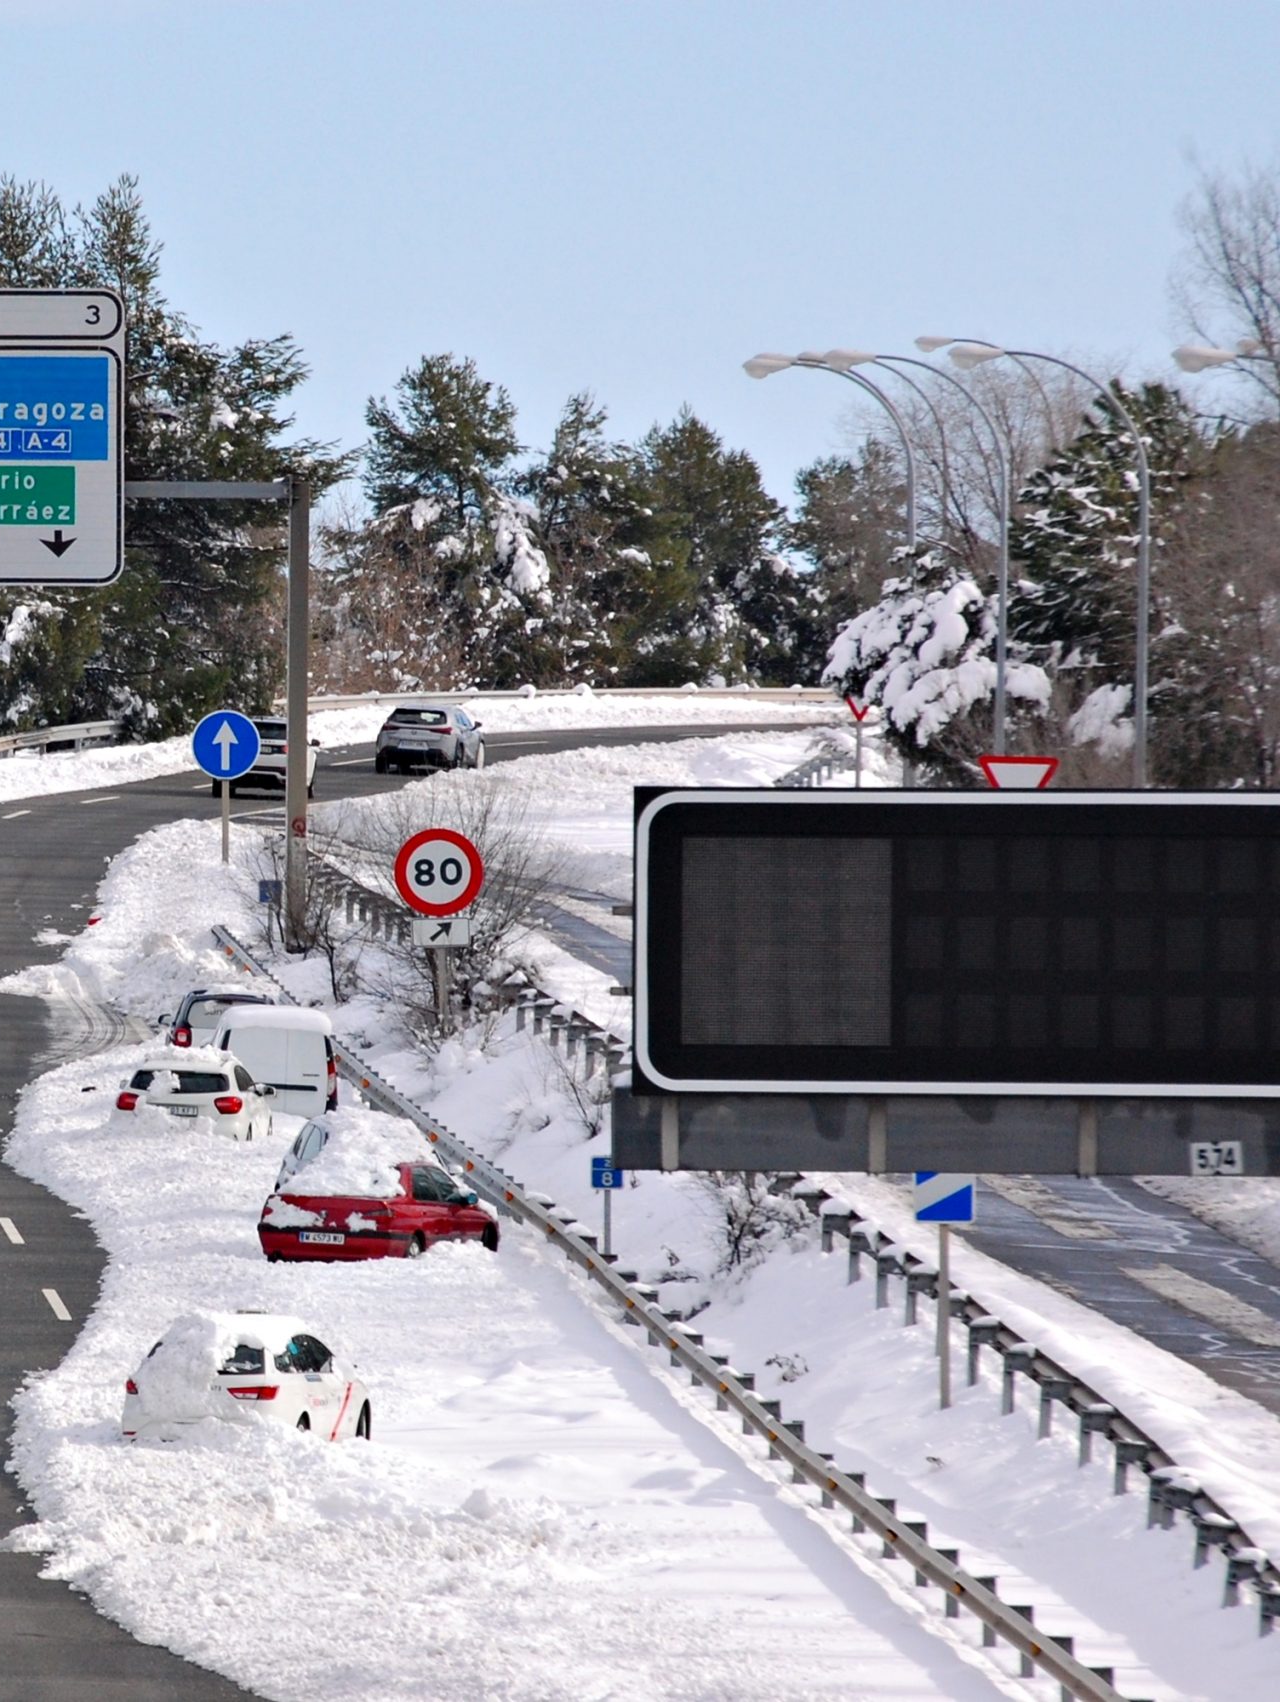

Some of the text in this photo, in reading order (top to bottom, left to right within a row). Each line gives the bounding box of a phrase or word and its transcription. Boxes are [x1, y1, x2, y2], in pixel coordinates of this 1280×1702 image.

[85, 304, 101, 326] 3
[27, 433, 68, 450] A-4
[414, 857, 463, 887] 80
[601, 1171, 613, 1187] 8
